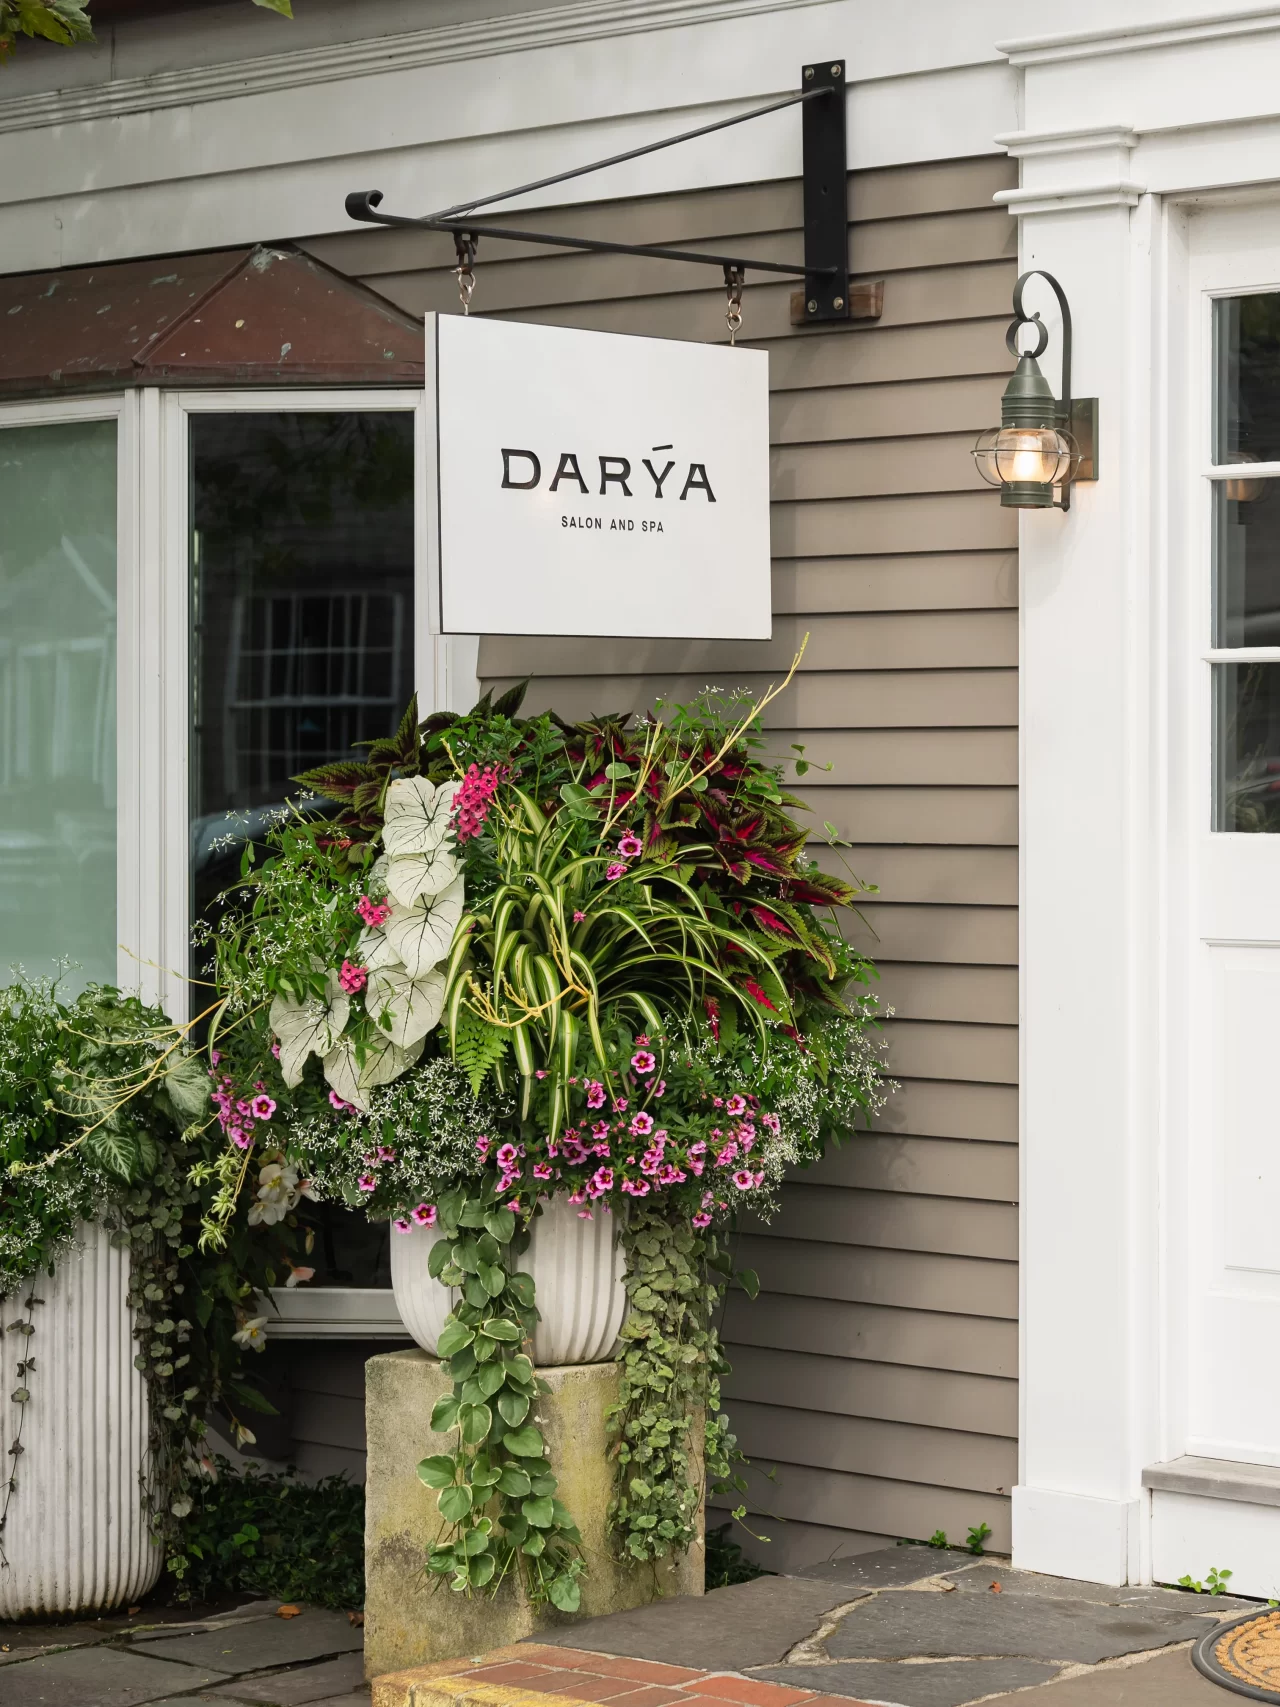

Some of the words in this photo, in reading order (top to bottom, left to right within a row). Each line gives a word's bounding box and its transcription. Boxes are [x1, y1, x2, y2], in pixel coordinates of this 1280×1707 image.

[561, 515, 602, 530] SALON
[609, 518, 635, 532] AND
[641, 520, 664, 533] SPA
